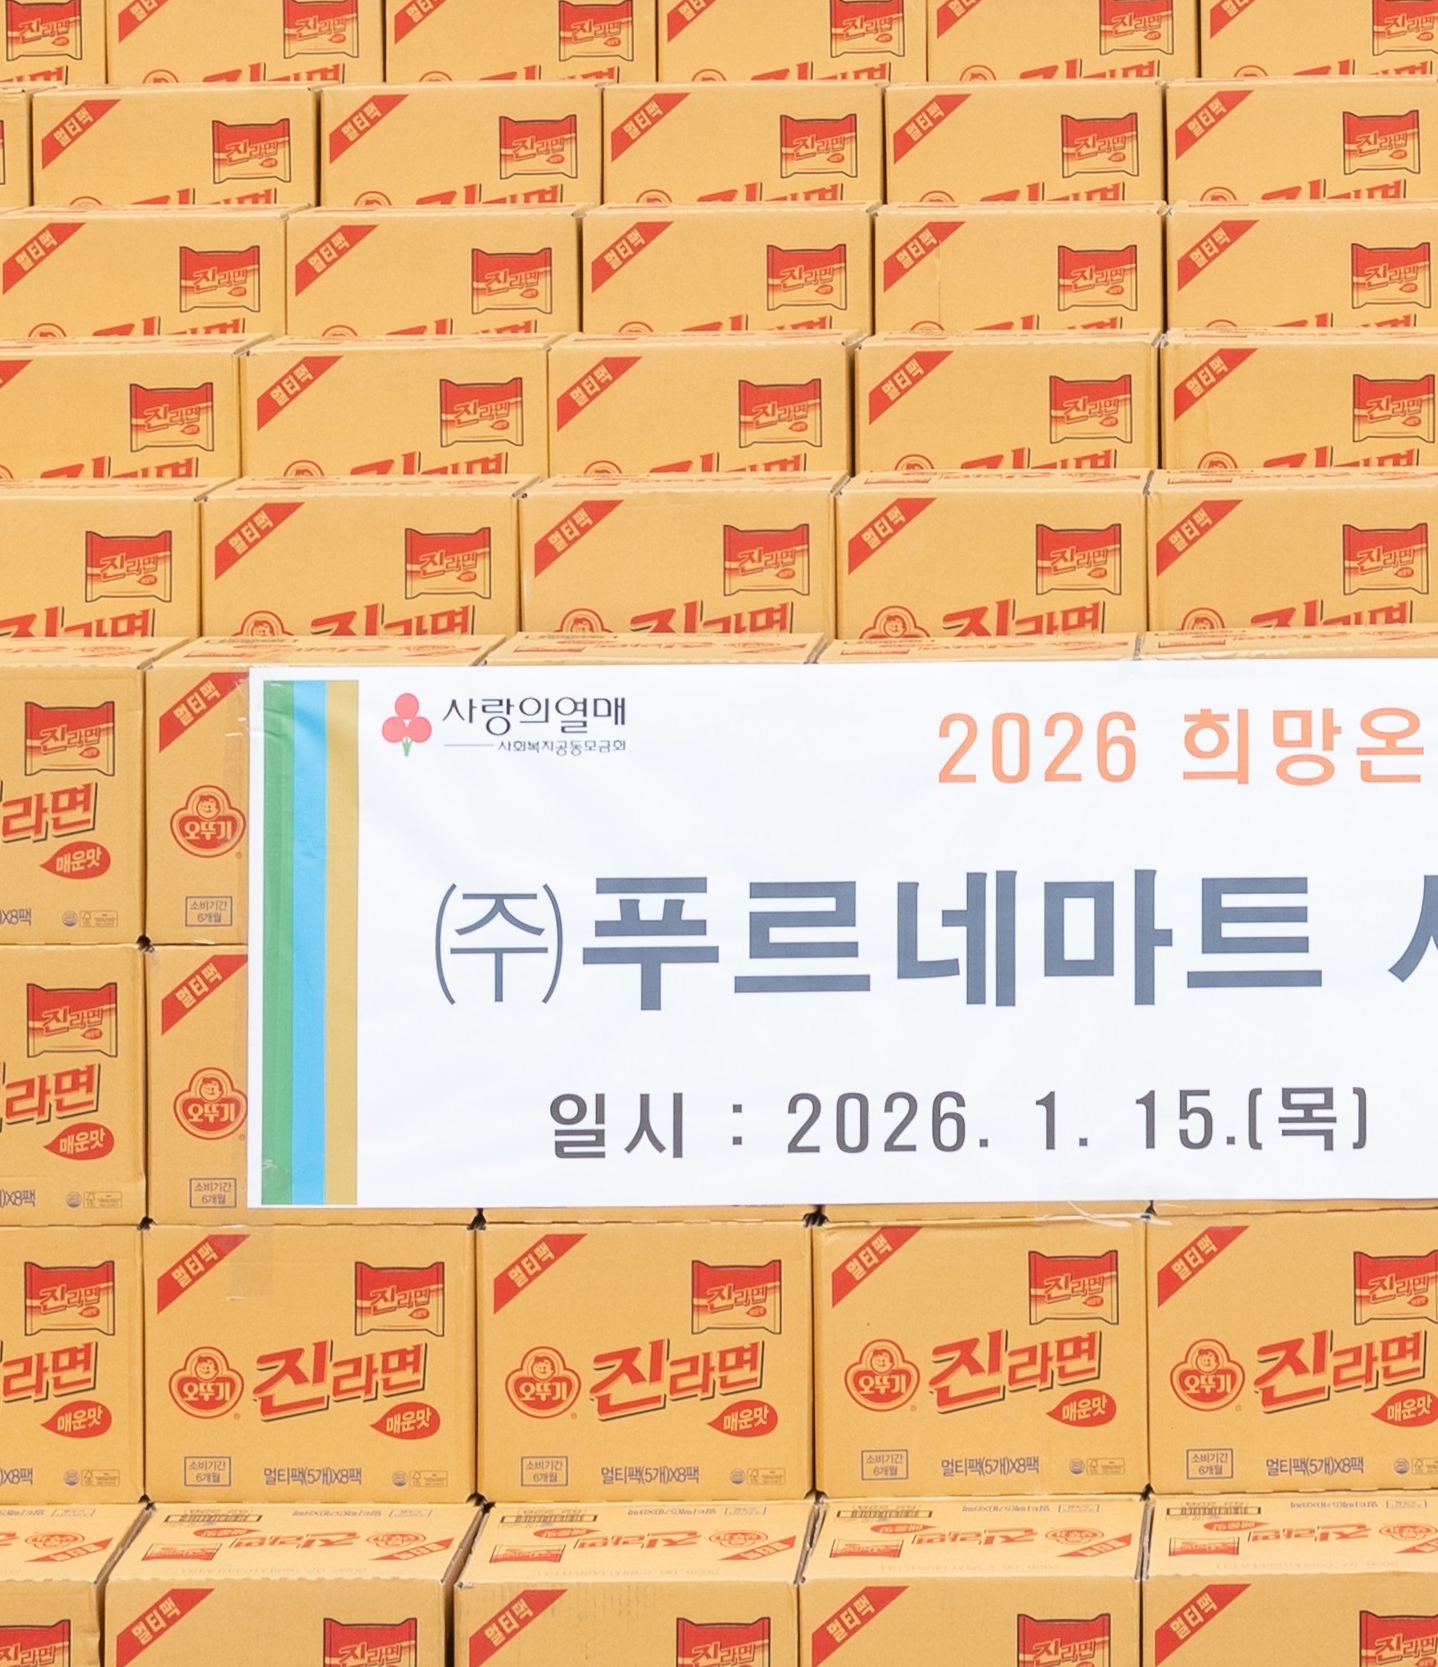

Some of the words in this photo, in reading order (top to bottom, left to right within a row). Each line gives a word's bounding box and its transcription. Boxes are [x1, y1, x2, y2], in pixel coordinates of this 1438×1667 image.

[1189, 227, 1231, 268] 멀티팩
[1357, 546, 1415, 573] 진라면
[442, 695, 628, 730] 사랑의열매
[497, 738, 627, 757] 사회복지공동모금회
[937, 711, 1137, 786] 2026
[548, 1090, 686, 1160] 일시
[787, 1090, 990, 1155] 2026.
[1036, 1090, 1090, 1153] 1.
[1135, 1085, 1369, 1154] 15.(목)
[590, 1339, 762, 1422] 진라면
